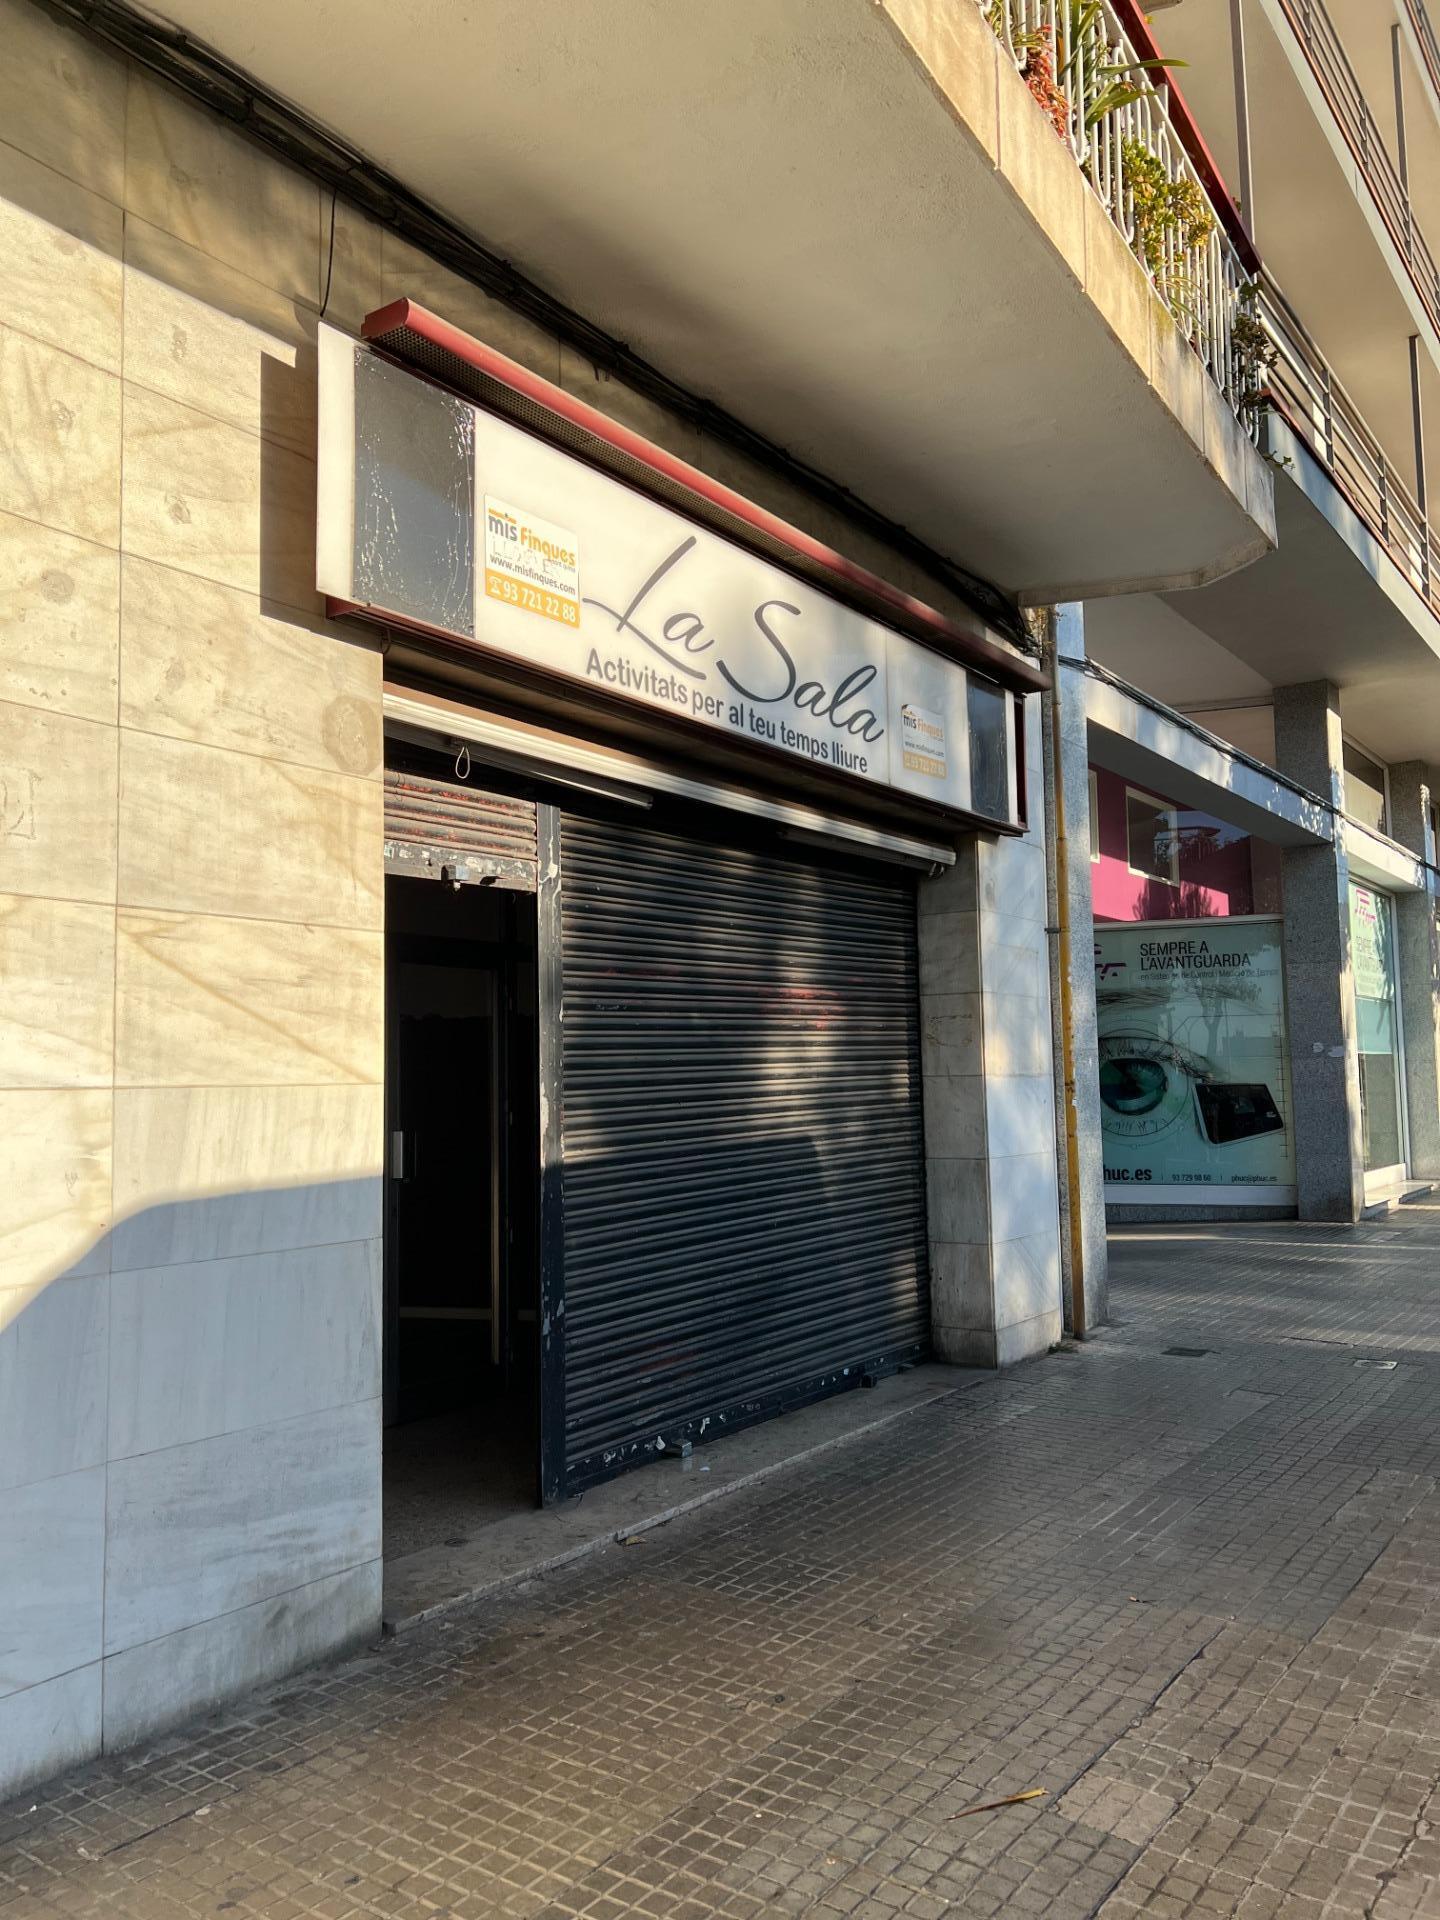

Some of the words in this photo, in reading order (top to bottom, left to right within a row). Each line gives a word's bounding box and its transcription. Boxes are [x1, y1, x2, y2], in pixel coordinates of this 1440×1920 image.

[488, 513, 518, 541] mis
[520, 526, 576, 567] Finques
[489, 554, 576, 596] www.misfinques.com
[503, 580, 518, 601] 93
[521, 587, 543, 611] 721
[545, 596, 560, 617] 22
[562, 604, 576, 623] 88
[582, 535, 715, 681] La
[715, 599, 885, 743] Sala
[586, 647, 688, 705] Activitats
[692, 689, 724, 716] per
[728, 703, 744, 728] al
[749, 708, 776, 740] teu
[780, 720, 829, 760] temps
[832, 740, 868, 773] lliure
[1140, 942, 1196, 957] SEMPRE
[1200, 941, 1209, 953] A
[1141, 953, 1251, 971] L'AVANTGUARDA
